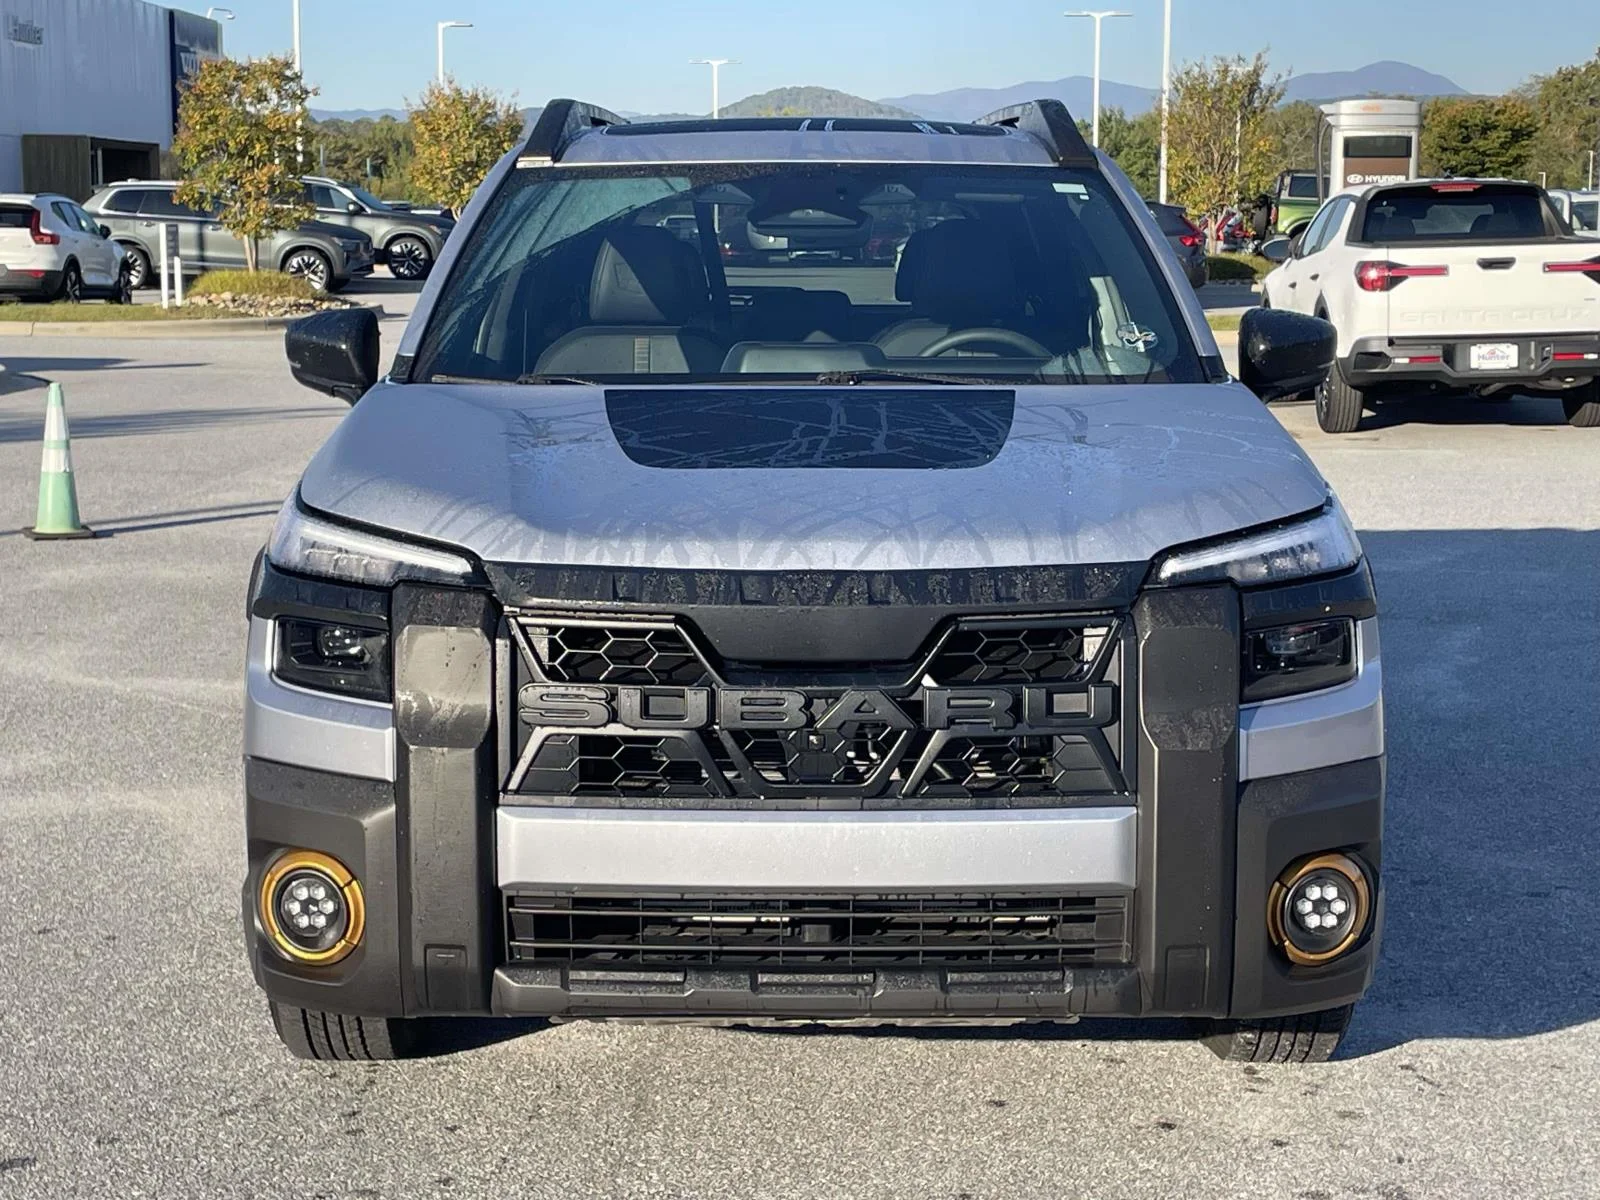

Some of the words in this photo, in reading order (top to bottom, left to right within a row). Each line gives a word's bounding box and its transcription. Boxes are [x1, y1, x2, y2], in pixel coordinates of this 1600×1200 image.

[1400, 308, 1502, 325] SANTA
[1511, 304, 1591, 322] CRUZ
[1477, 353, 1510, 361] Hunter
[519, 682, 1119, 731] SUBARU
